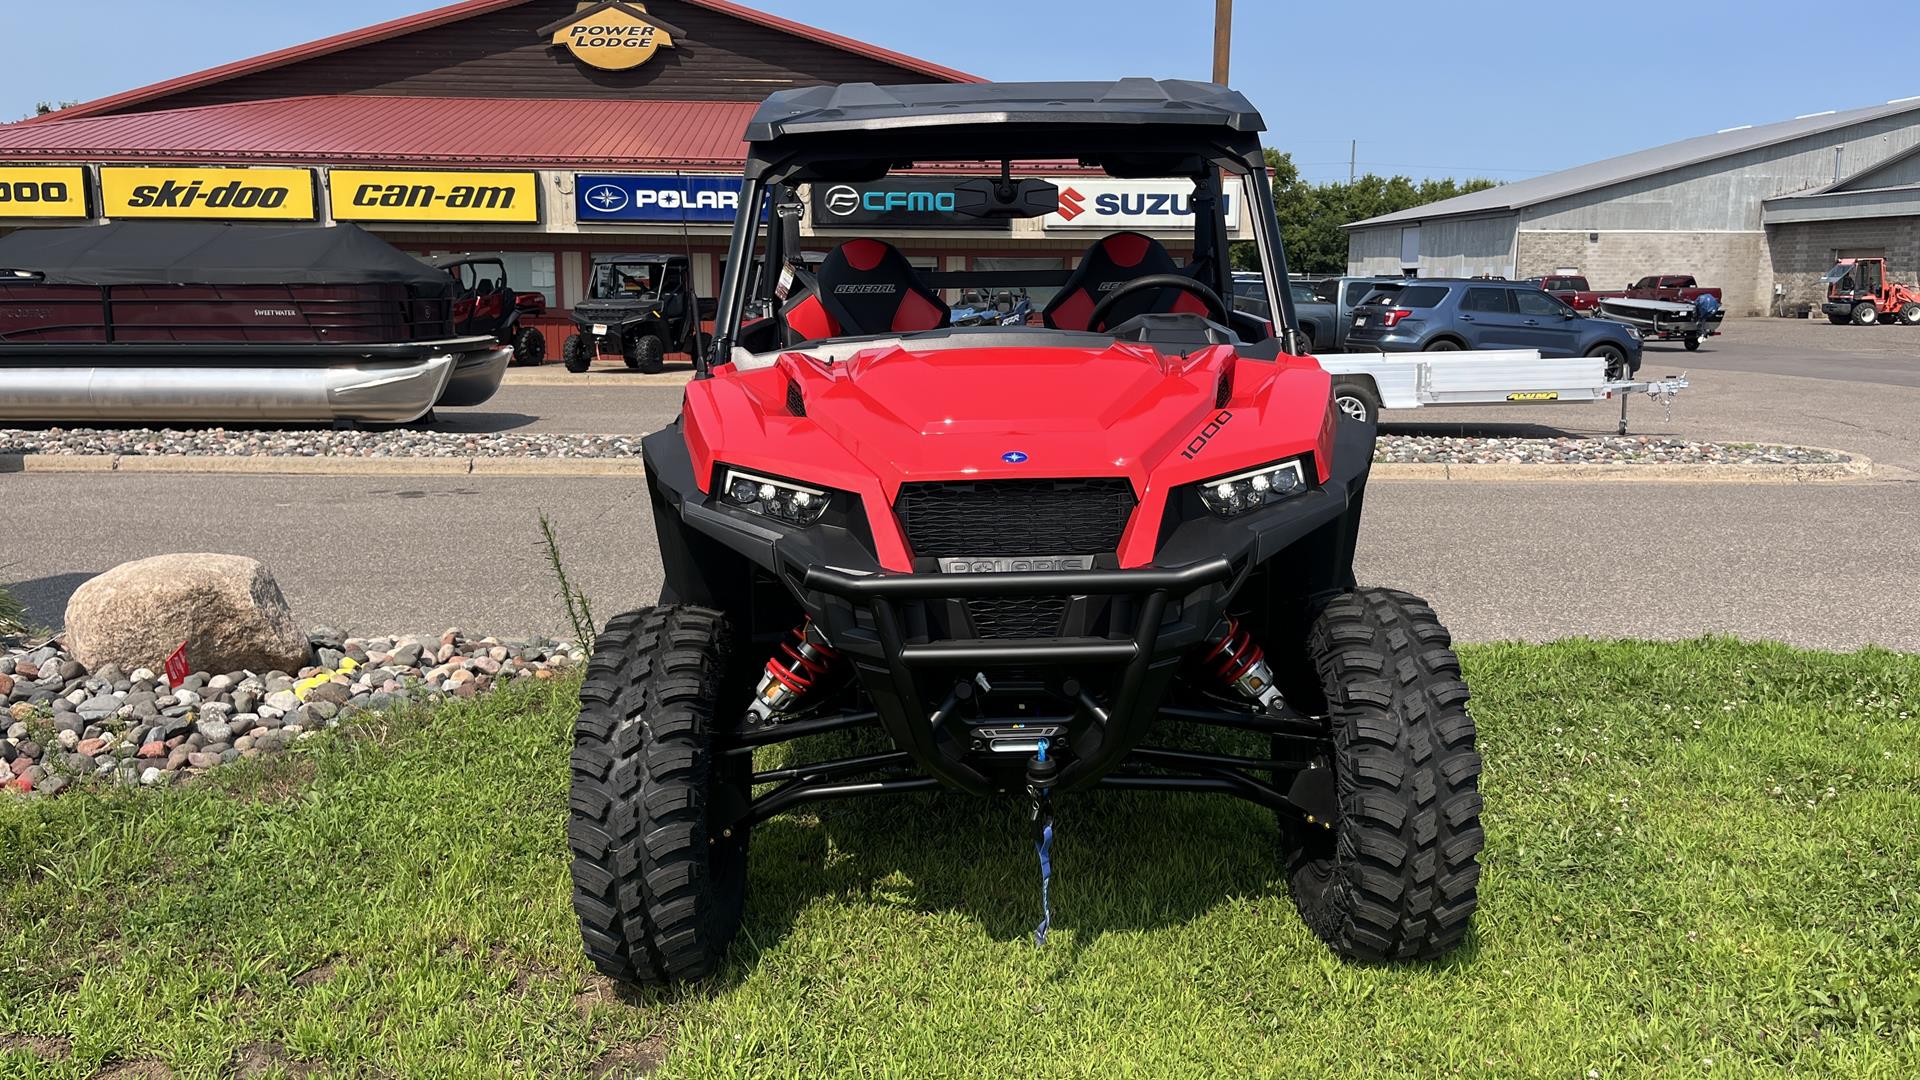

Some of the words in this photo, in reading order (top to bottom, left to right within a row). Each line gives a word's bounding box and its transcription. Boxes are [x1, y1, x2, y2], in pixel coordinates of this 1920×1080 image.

[570, 26, 655, 37] POWER
[575, 36, 652, 47] LODGE
[127, 180, 289, 208] ski-doo
[353, 184, 516, 208] can-am
[636, 190, 771, 209] POLAR
[863, 191, 955, 211] CFMO
[1095, 193, 1230, 215] SUZUI
[834, 284, 896, 294] GENERAL
[1180, 410, 1233, 460] 1000
